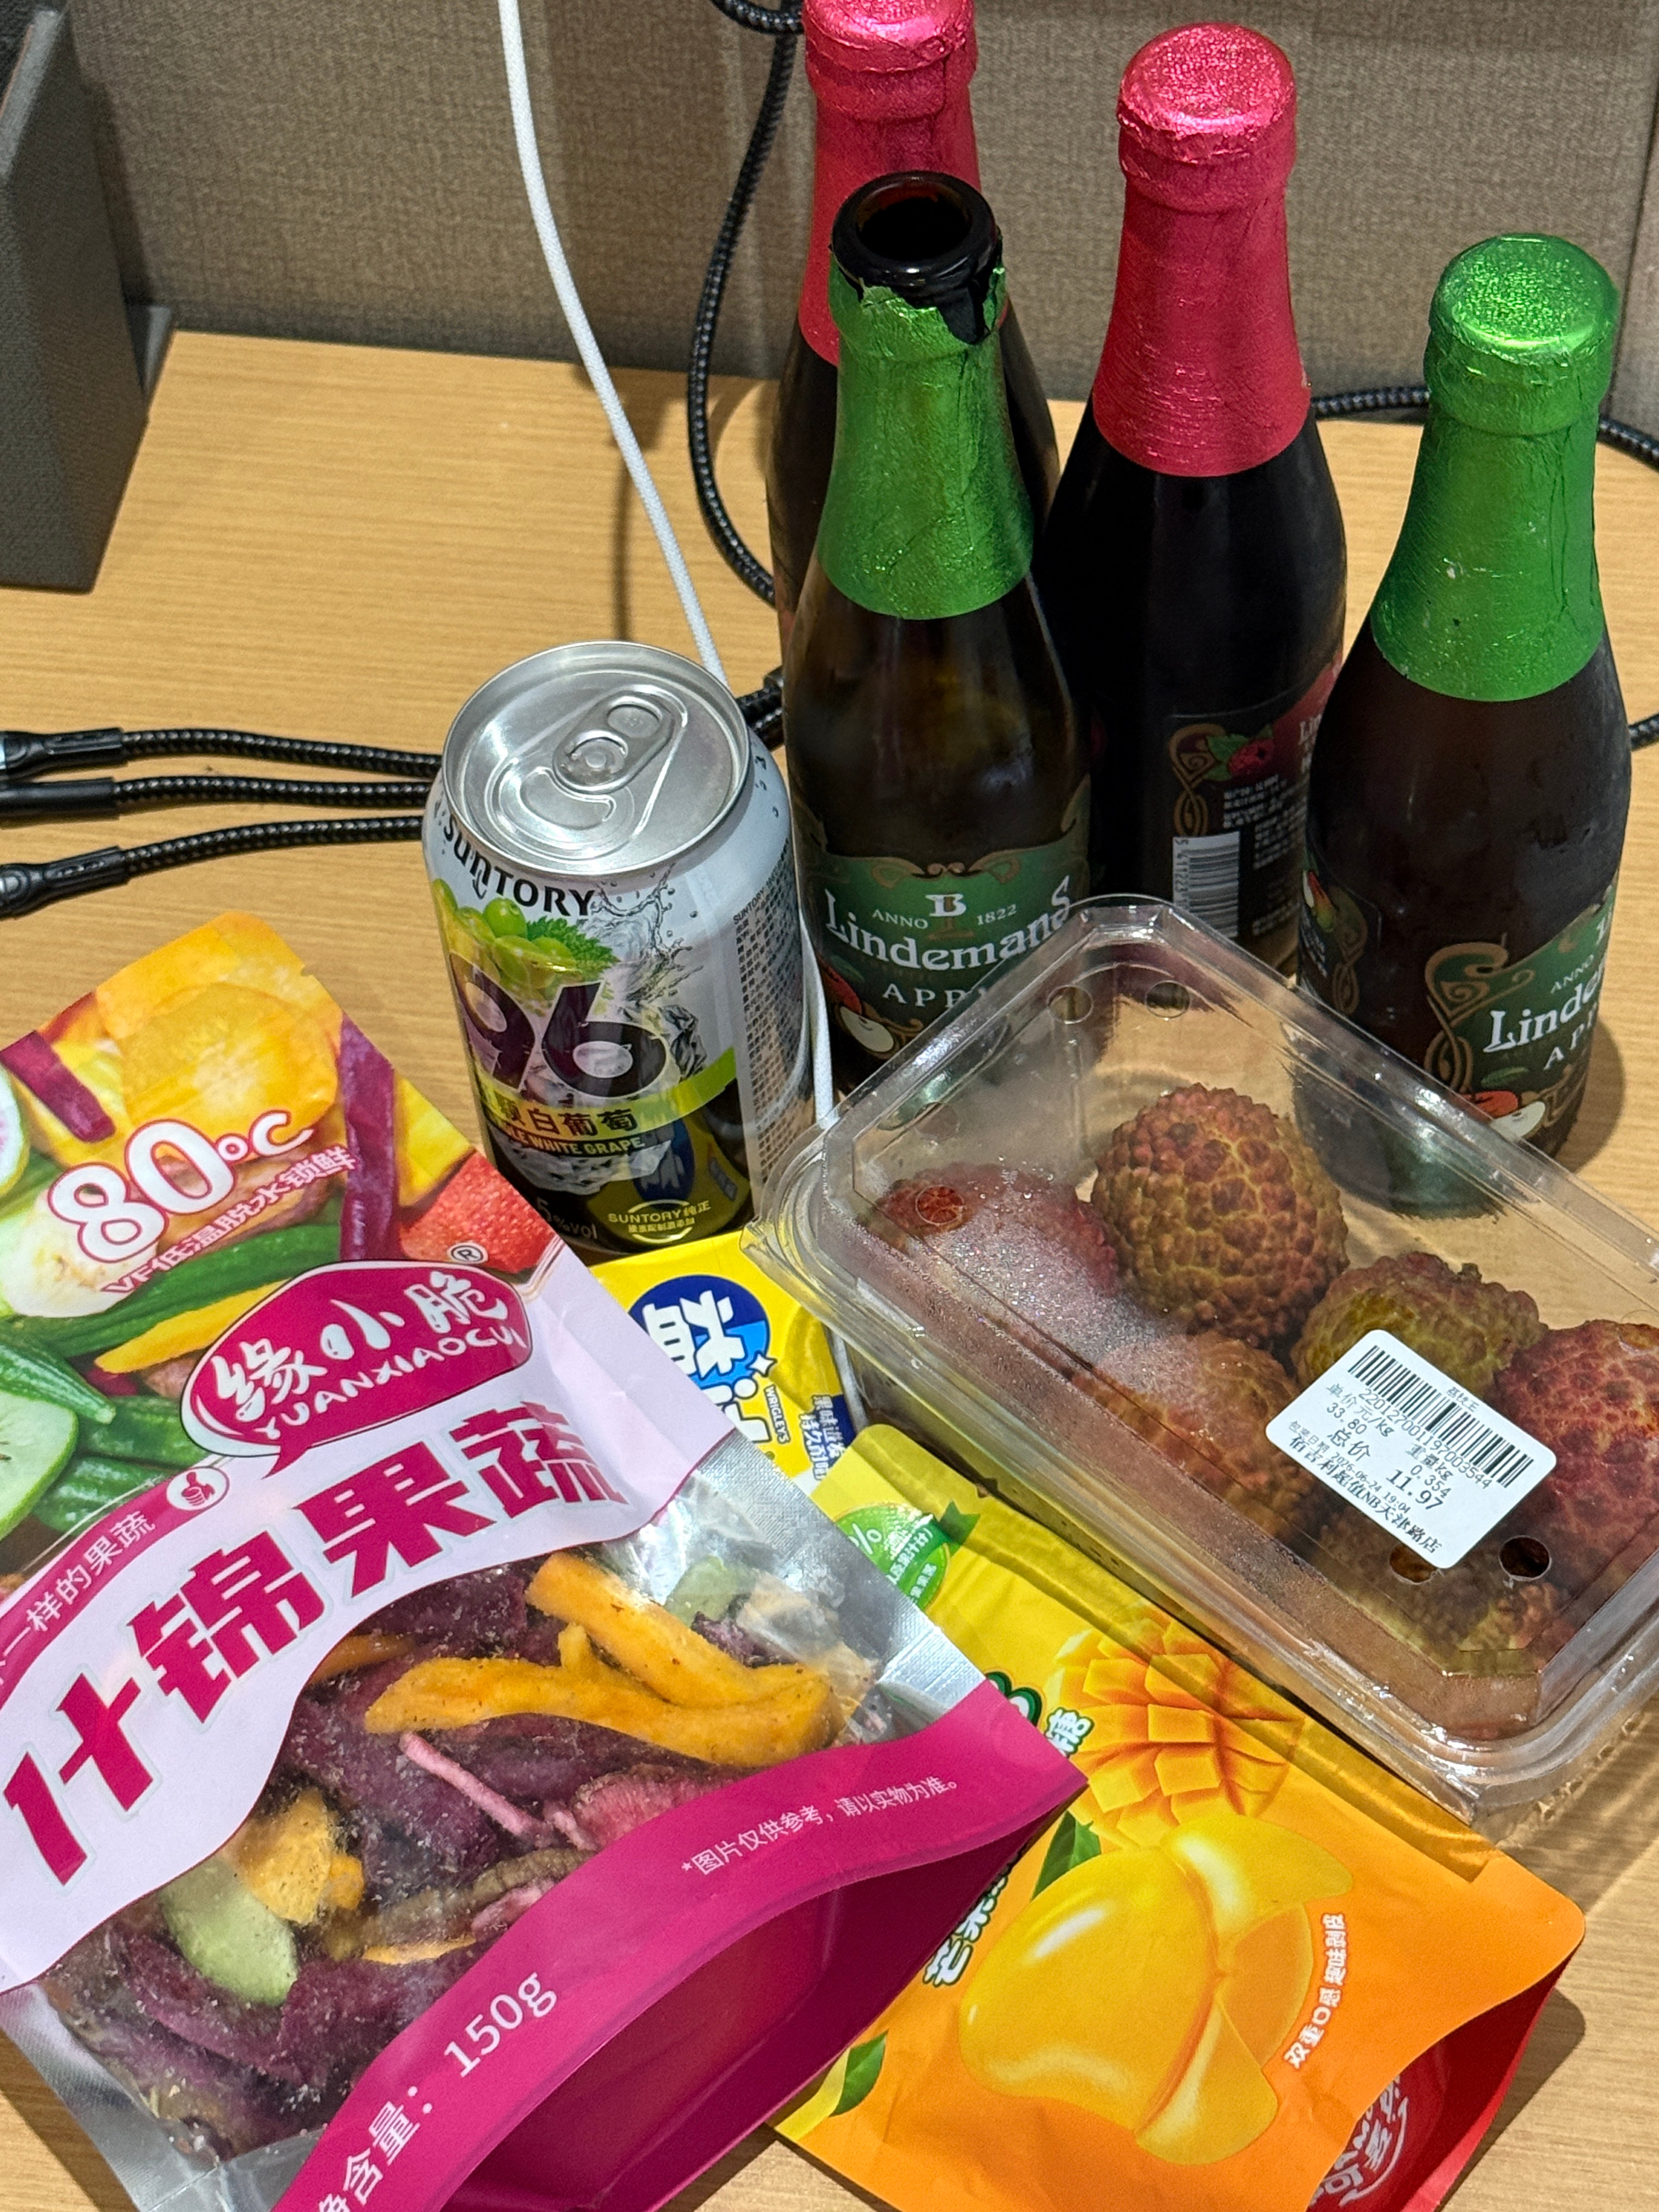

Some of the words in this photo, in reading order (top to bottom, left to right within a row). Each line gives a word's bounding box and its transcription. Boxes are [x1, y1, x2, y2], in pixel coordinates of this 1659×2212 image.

[443, 813, 595, 916] SUNTORY
[825, 874, 1073, 970] Lindemans
[873, 909, 928, 930] ANNO
[977, 903, 1017, 926] 1822
[528, 1136, 580, 1155] WHITE
[583, 1137, 645, 1155] GRAPE
[101, 1146, 358, 1294] VF低温脱水锁鲜
[608, 1209, 681, 1223] SUNTORY
[213, 1272, 509, 1423] 缘小脆
[256, 1324, 528, 1440] YUANXIAOCUI
[1327, 1402, 1368, 1435] 33.80
[1410, 1464, 1452, 1498] 0.354
[1327, 1428, 1371, 1462] 总价
[1386, 1468, 1444, 1511] 11.97
[0, 1510, 156, 1686] 一样的果蔬
[3, 1402, 629, 1886] 什锦果蔬
[444, 1972, 557, 2078] 150g
